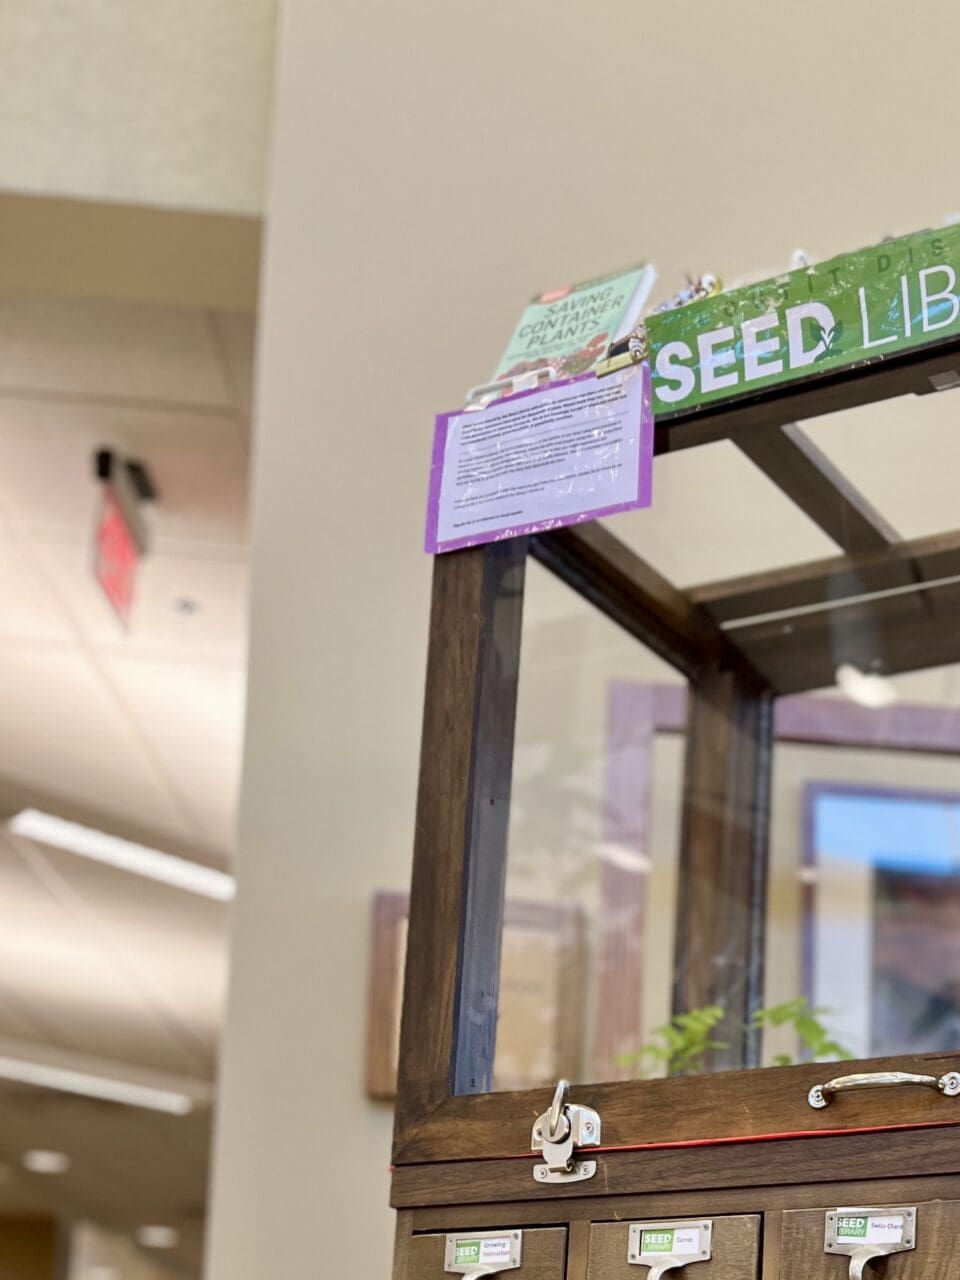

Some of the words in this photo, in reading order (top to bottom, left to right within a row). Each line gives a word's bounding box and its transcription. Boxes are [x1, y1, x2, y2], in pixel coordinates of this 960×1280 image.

[518, 295, 624, 338] CONTAINER
[545, 286, 614, 318] SAVING
[526, 316, 601, 349] PLANTS
[654, 302, 837, 403] SEED
[645, 1233, 671, 1243] SEED
[838, 1218, 864, 1228] SEED
[456, 1246, 479, 1256] SEED
